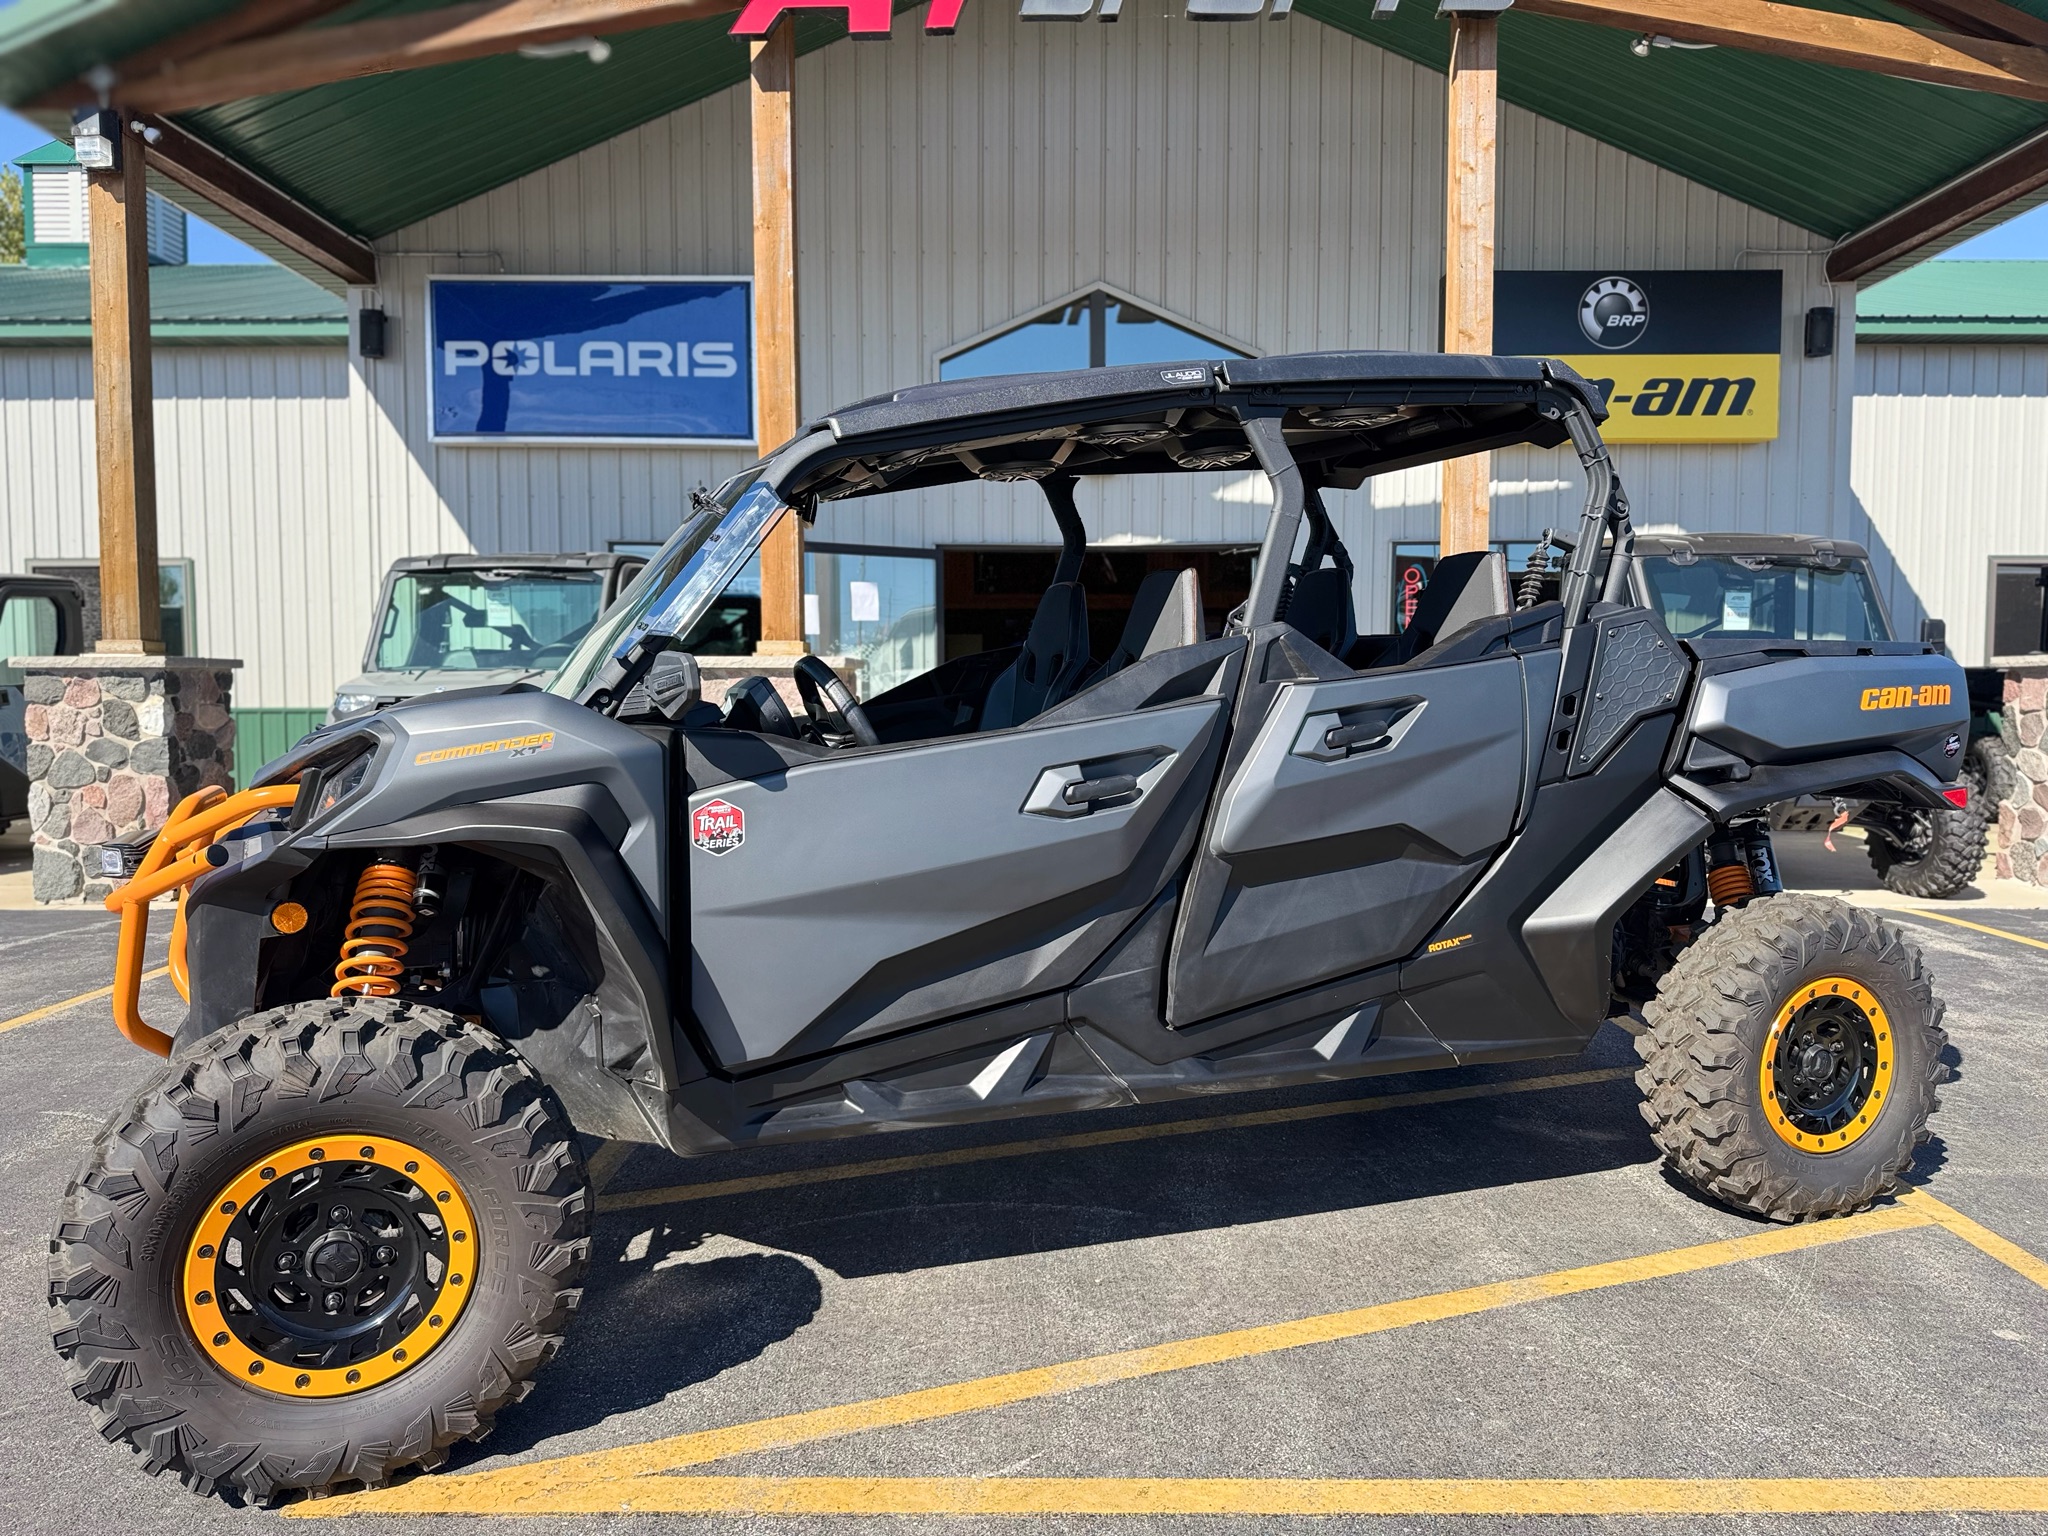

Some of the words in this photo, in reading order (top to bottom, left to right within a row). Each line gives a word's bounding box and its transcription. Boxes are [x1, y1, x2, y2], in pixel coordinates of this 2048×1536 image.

[1606, 314, 1646, 327] BRP
[444, 340, 738, 377] POLARIS
[1175, 370, 1203, 378] AUDIO
[1860, 684, 1951, 711] can-am
[415, 732, 555, 765] COMMANDER
[697, 815, 738, 831] TRAIL
[703, 837, 740, 849] SERIES
[1750, 847, 1774, 885] FOX
[1428, 937, 1460, 952] ROTAX
